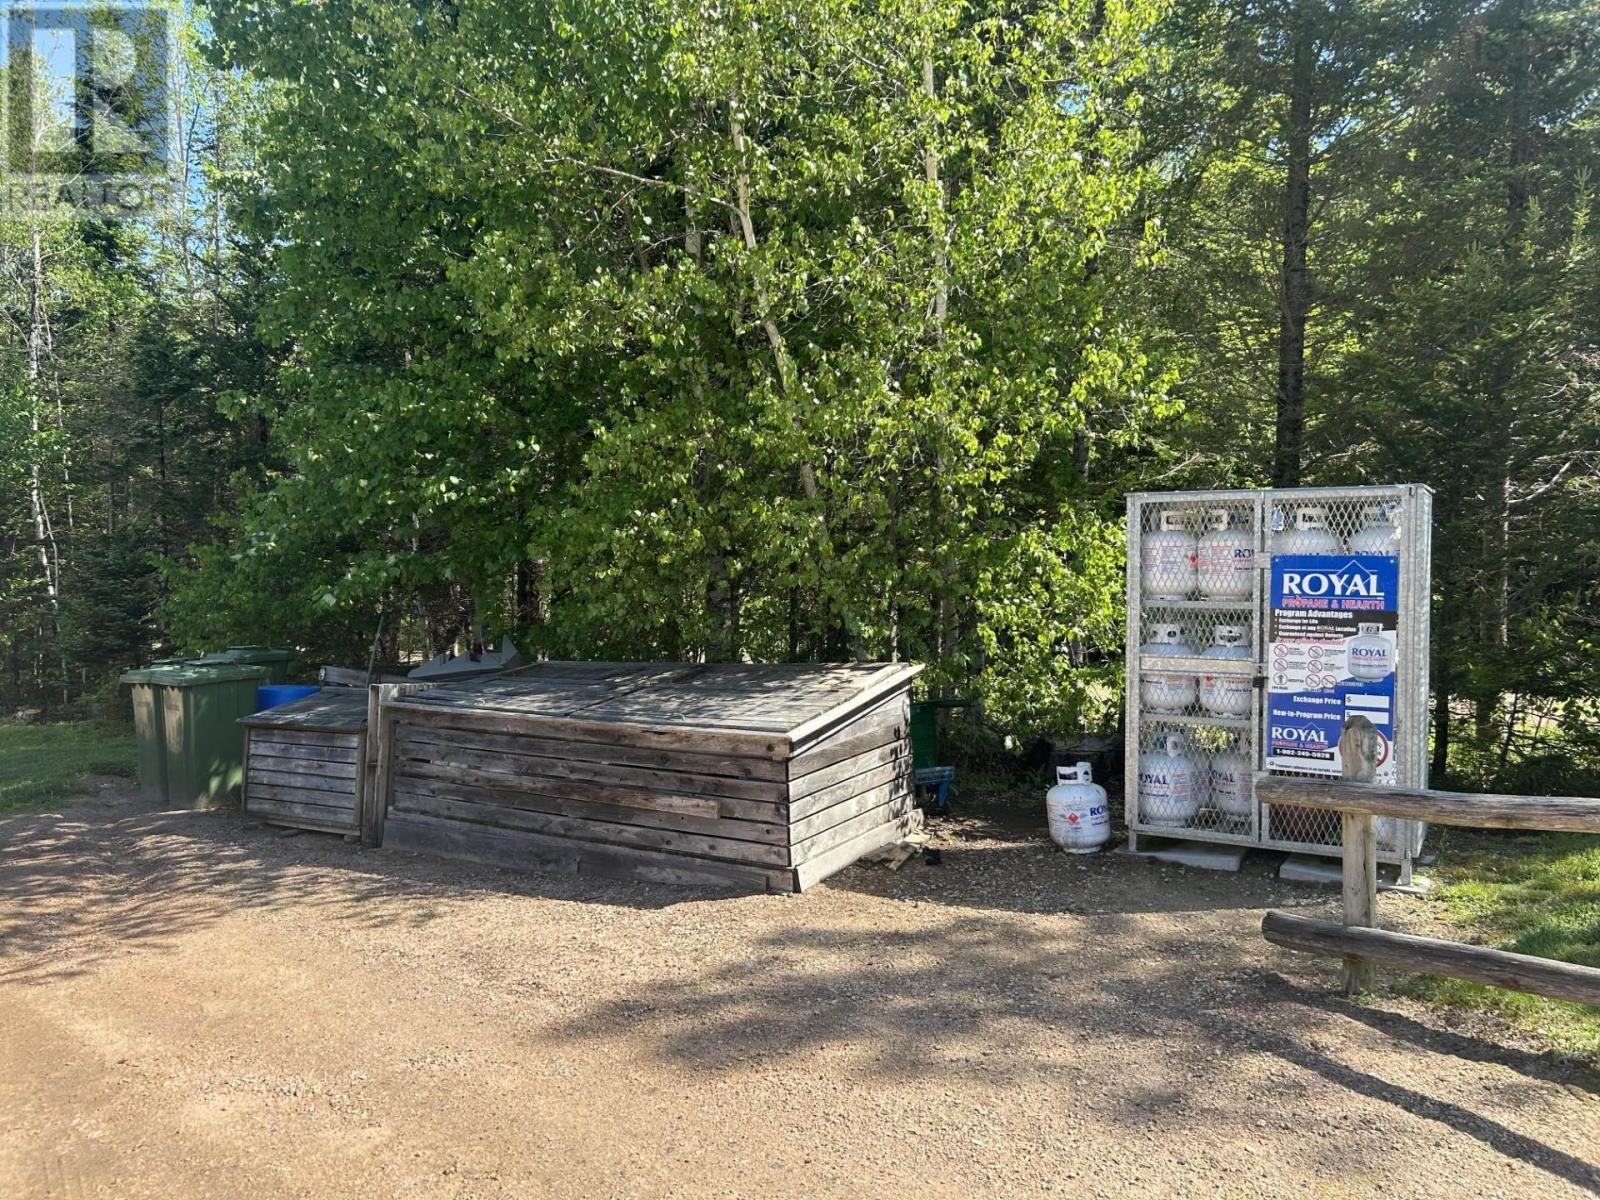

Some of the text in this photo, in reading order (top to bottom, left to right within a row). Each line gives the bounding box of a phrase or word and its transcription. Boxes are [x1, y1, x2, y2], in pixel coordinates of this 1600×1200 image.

[1282, 573, 1385, 596] ROYAL
[1282, 598, 1385, 610] PROPANE & HEARTH
[1274, 609, 1354, 619] Program Advantages
[1352, 648, 1387, 657] ROYAL
[1293, 695, 1324, 704] Exchange
[1273, 709, 1323, 719] New-to-Program
[1272, 727, 1329, 743] ROYAL
[1139, 773, 1170, 785] OYAL
[1211, 769, 1236, 783] OYAL
